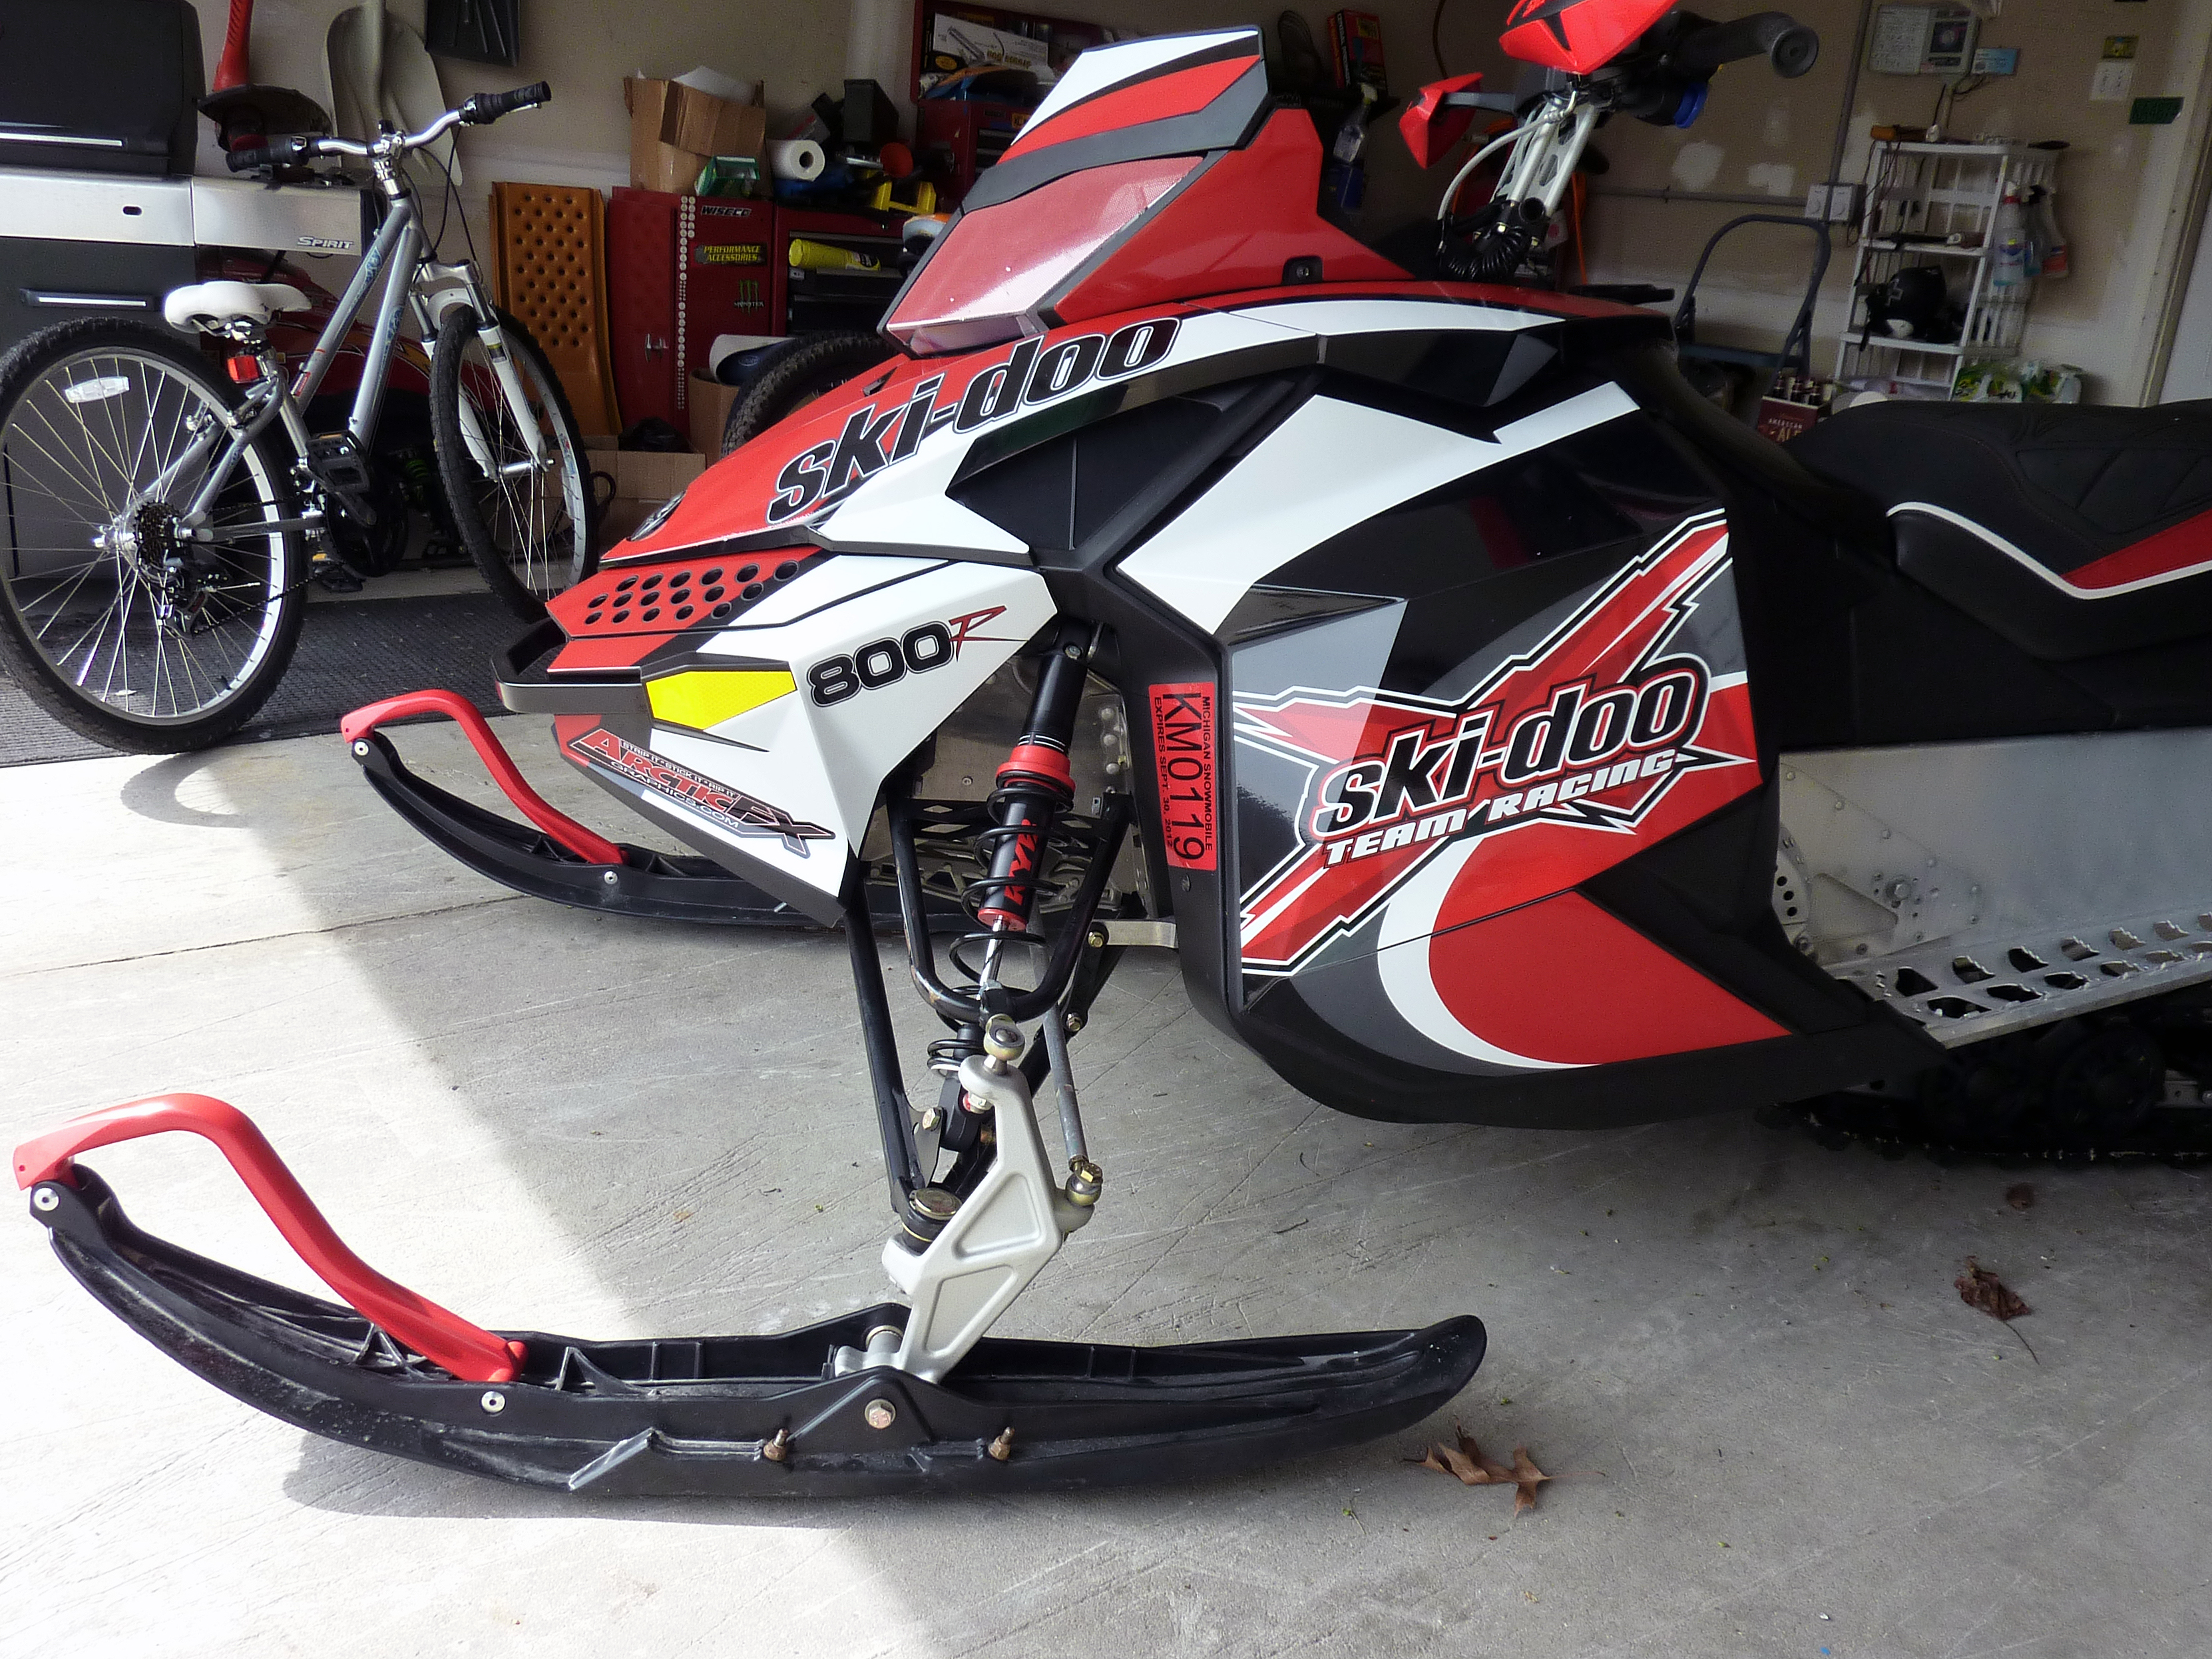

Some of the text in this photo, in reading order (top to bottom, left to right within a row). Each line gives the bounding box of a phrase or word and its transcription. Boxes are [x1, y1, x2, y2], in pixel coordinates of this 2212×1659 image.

[297, 236, 353, 249] SPIRIT
[704, 245, 761, 254] PERFORMANCE
[707, 253, 758, 262] ACCESSORIES
[1155, 697, 1166, 752] EXPIRES
[622, 741, 650, 757] STRIP
[666, 762, 693, 778] STICK
[708, 781, 725, 794] RIP
[1160, 756, 1170, 793] SEPT.
[1162, 693, 1205, 859] KM0119
[1202, 696, 1213, 851] MICHIGAN SNOWMOBILE
[610, 761, 739, 829] GRAPHICS.COM
[1326, 748, 1677, 867] TEAM RACING
